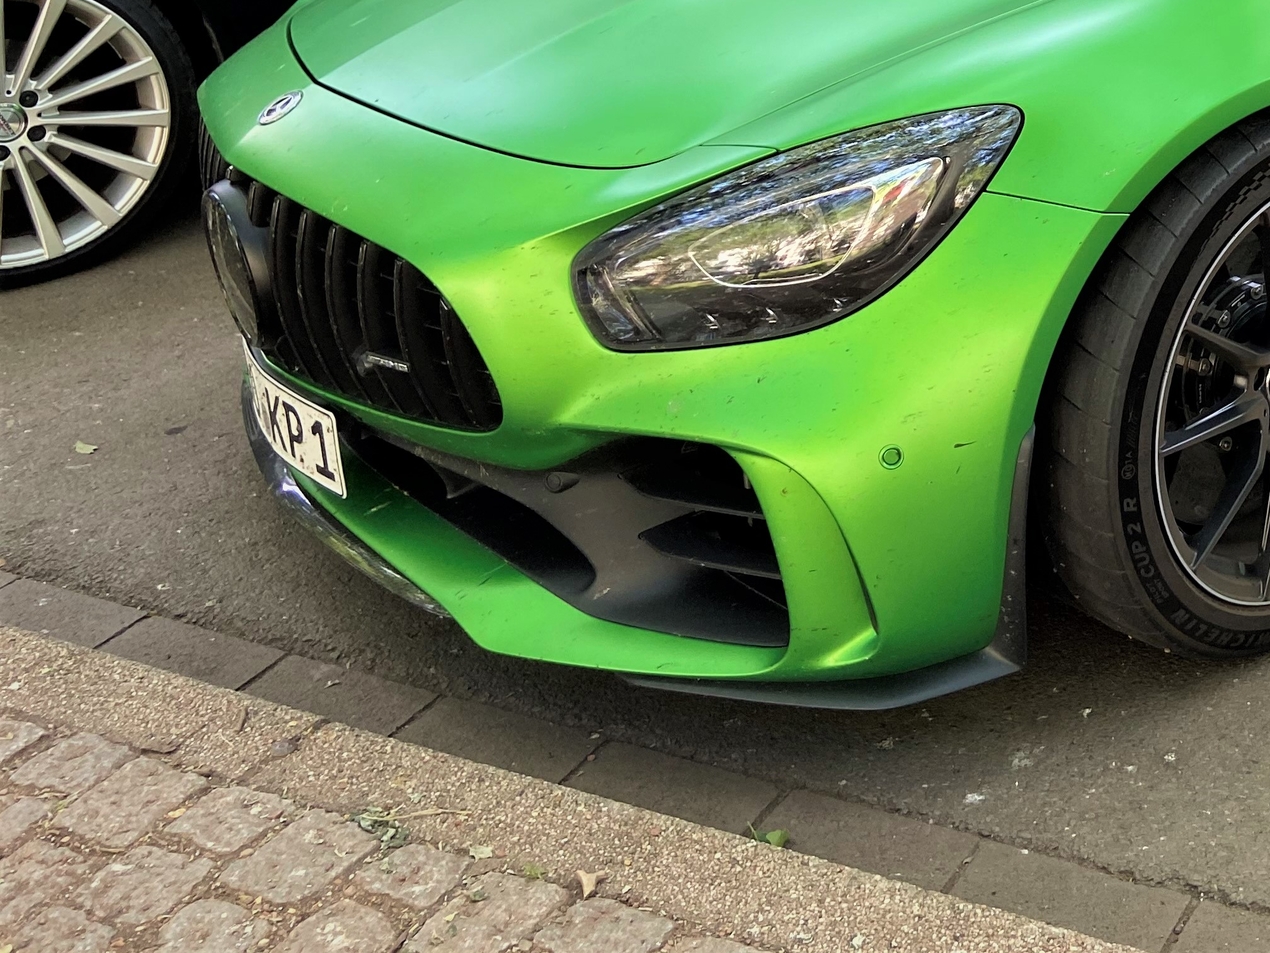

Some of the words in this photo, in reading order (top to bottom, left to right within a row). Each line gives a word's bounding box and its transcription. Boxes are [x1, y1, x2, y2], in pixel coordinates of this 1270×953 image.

[311, 420, 336, 482] 1
[1123, 497, 1138, 512] R
[1126, 522, 1142, 536] 2
[1132, 541, 1155, 578] CUP
